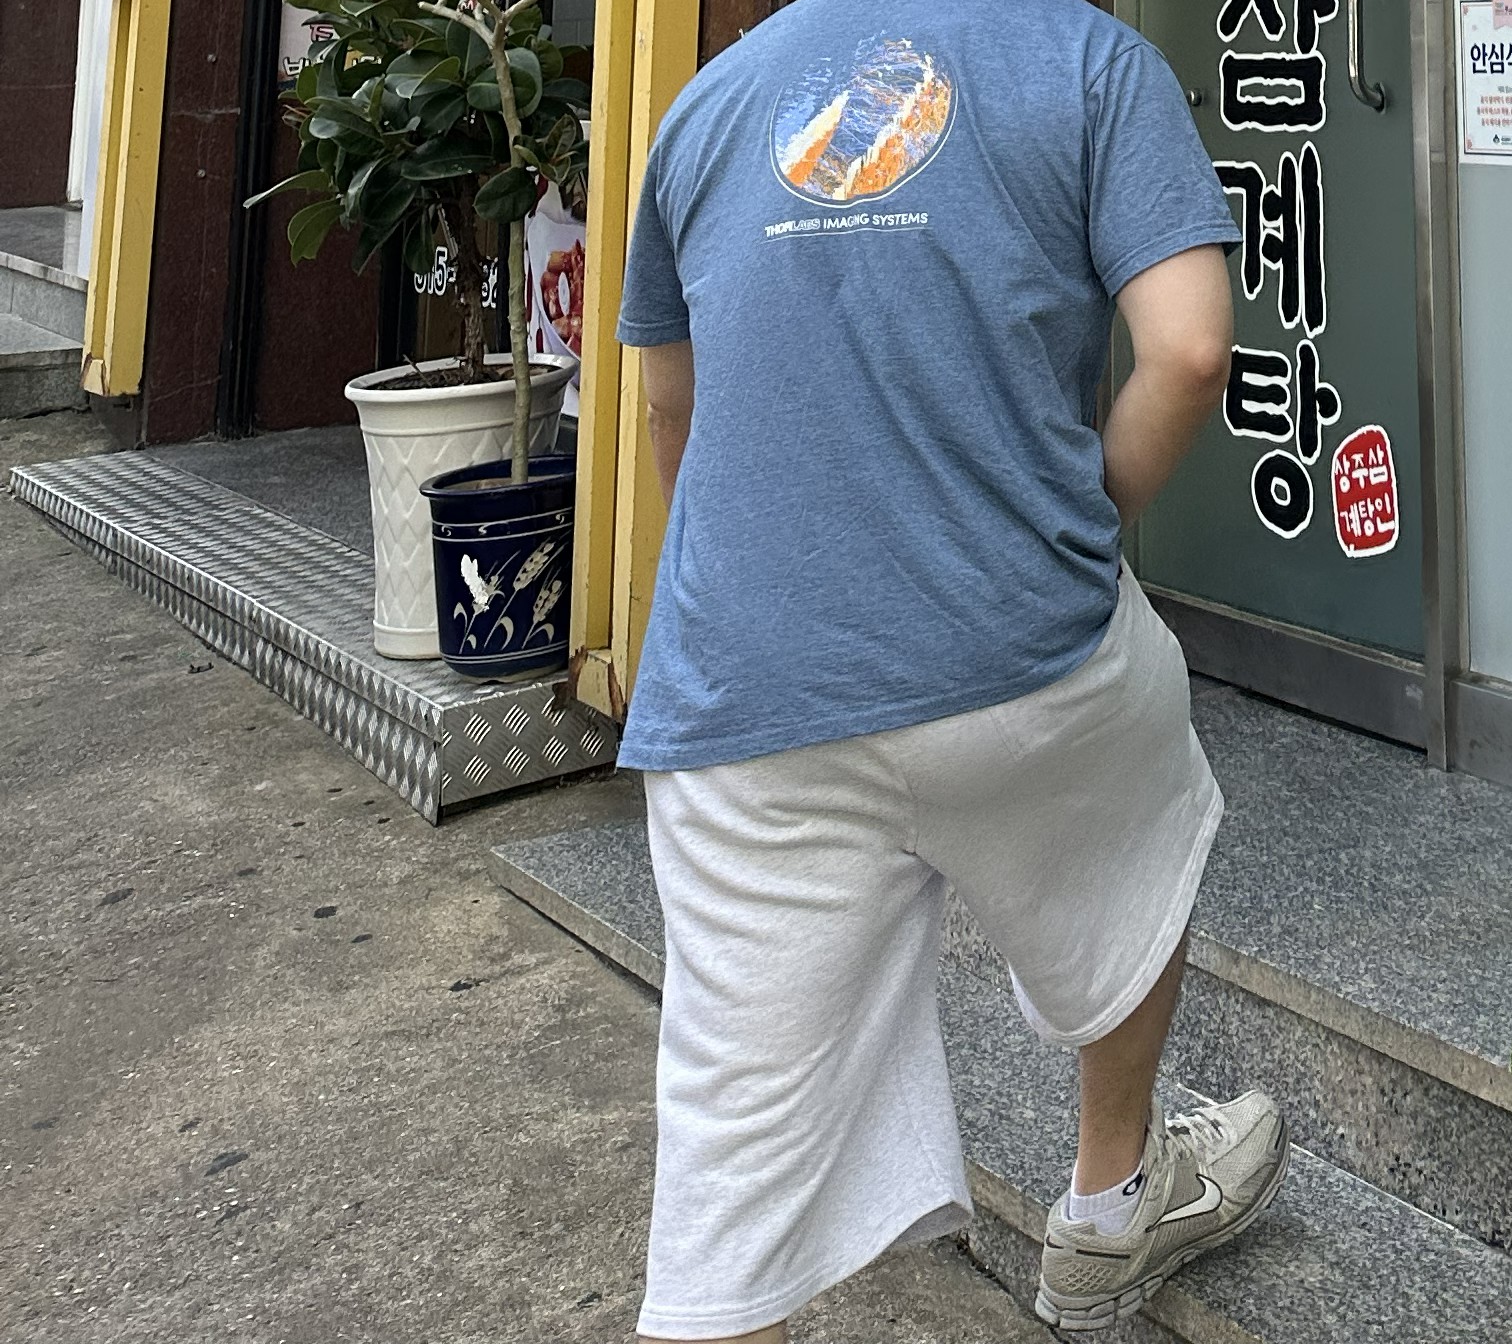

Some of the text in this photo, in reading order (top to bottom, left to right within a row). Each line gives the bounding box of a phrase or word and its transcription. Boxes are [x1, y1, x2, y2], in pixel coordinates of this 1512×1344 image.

[823, 212, 870, 230] IMAGING
[871, 211, 928, 226] SYSTEMS
[1334, 443, 1389, 493] 상주삼
